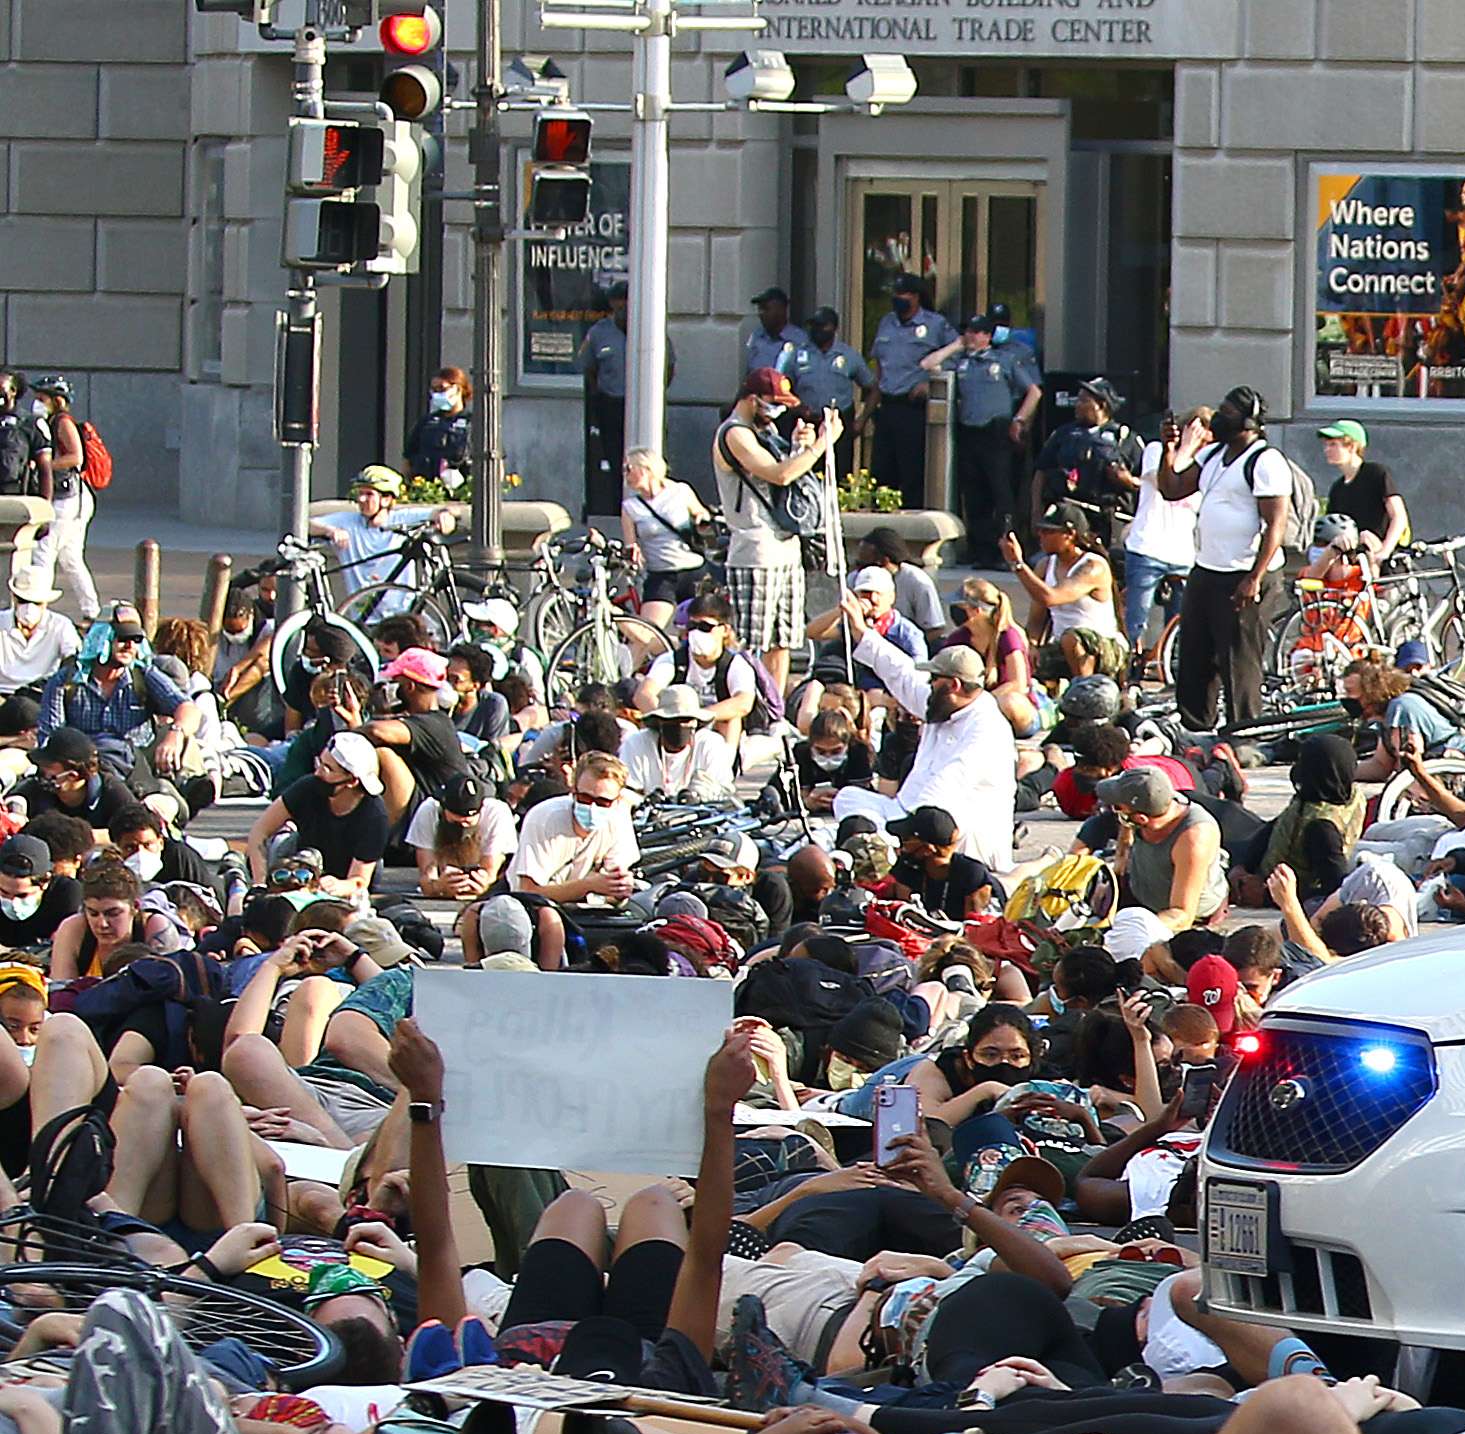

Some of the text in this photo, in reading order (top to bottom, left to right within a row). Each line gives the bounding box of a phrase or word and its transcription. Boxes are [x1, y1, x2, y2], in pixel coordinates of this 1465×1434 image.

[952, 18, 1035, 42] TRADE
[1051, 18, 1153, 44] CENTER
[599, 213, 623, 237] OF
[1329, 199, 1415, 226] Where
[531, 245, 625, 269] INFLUENCE
[1329, 233, 1430, 260] Nations
[1329, 266, 1436, 294] Connect
